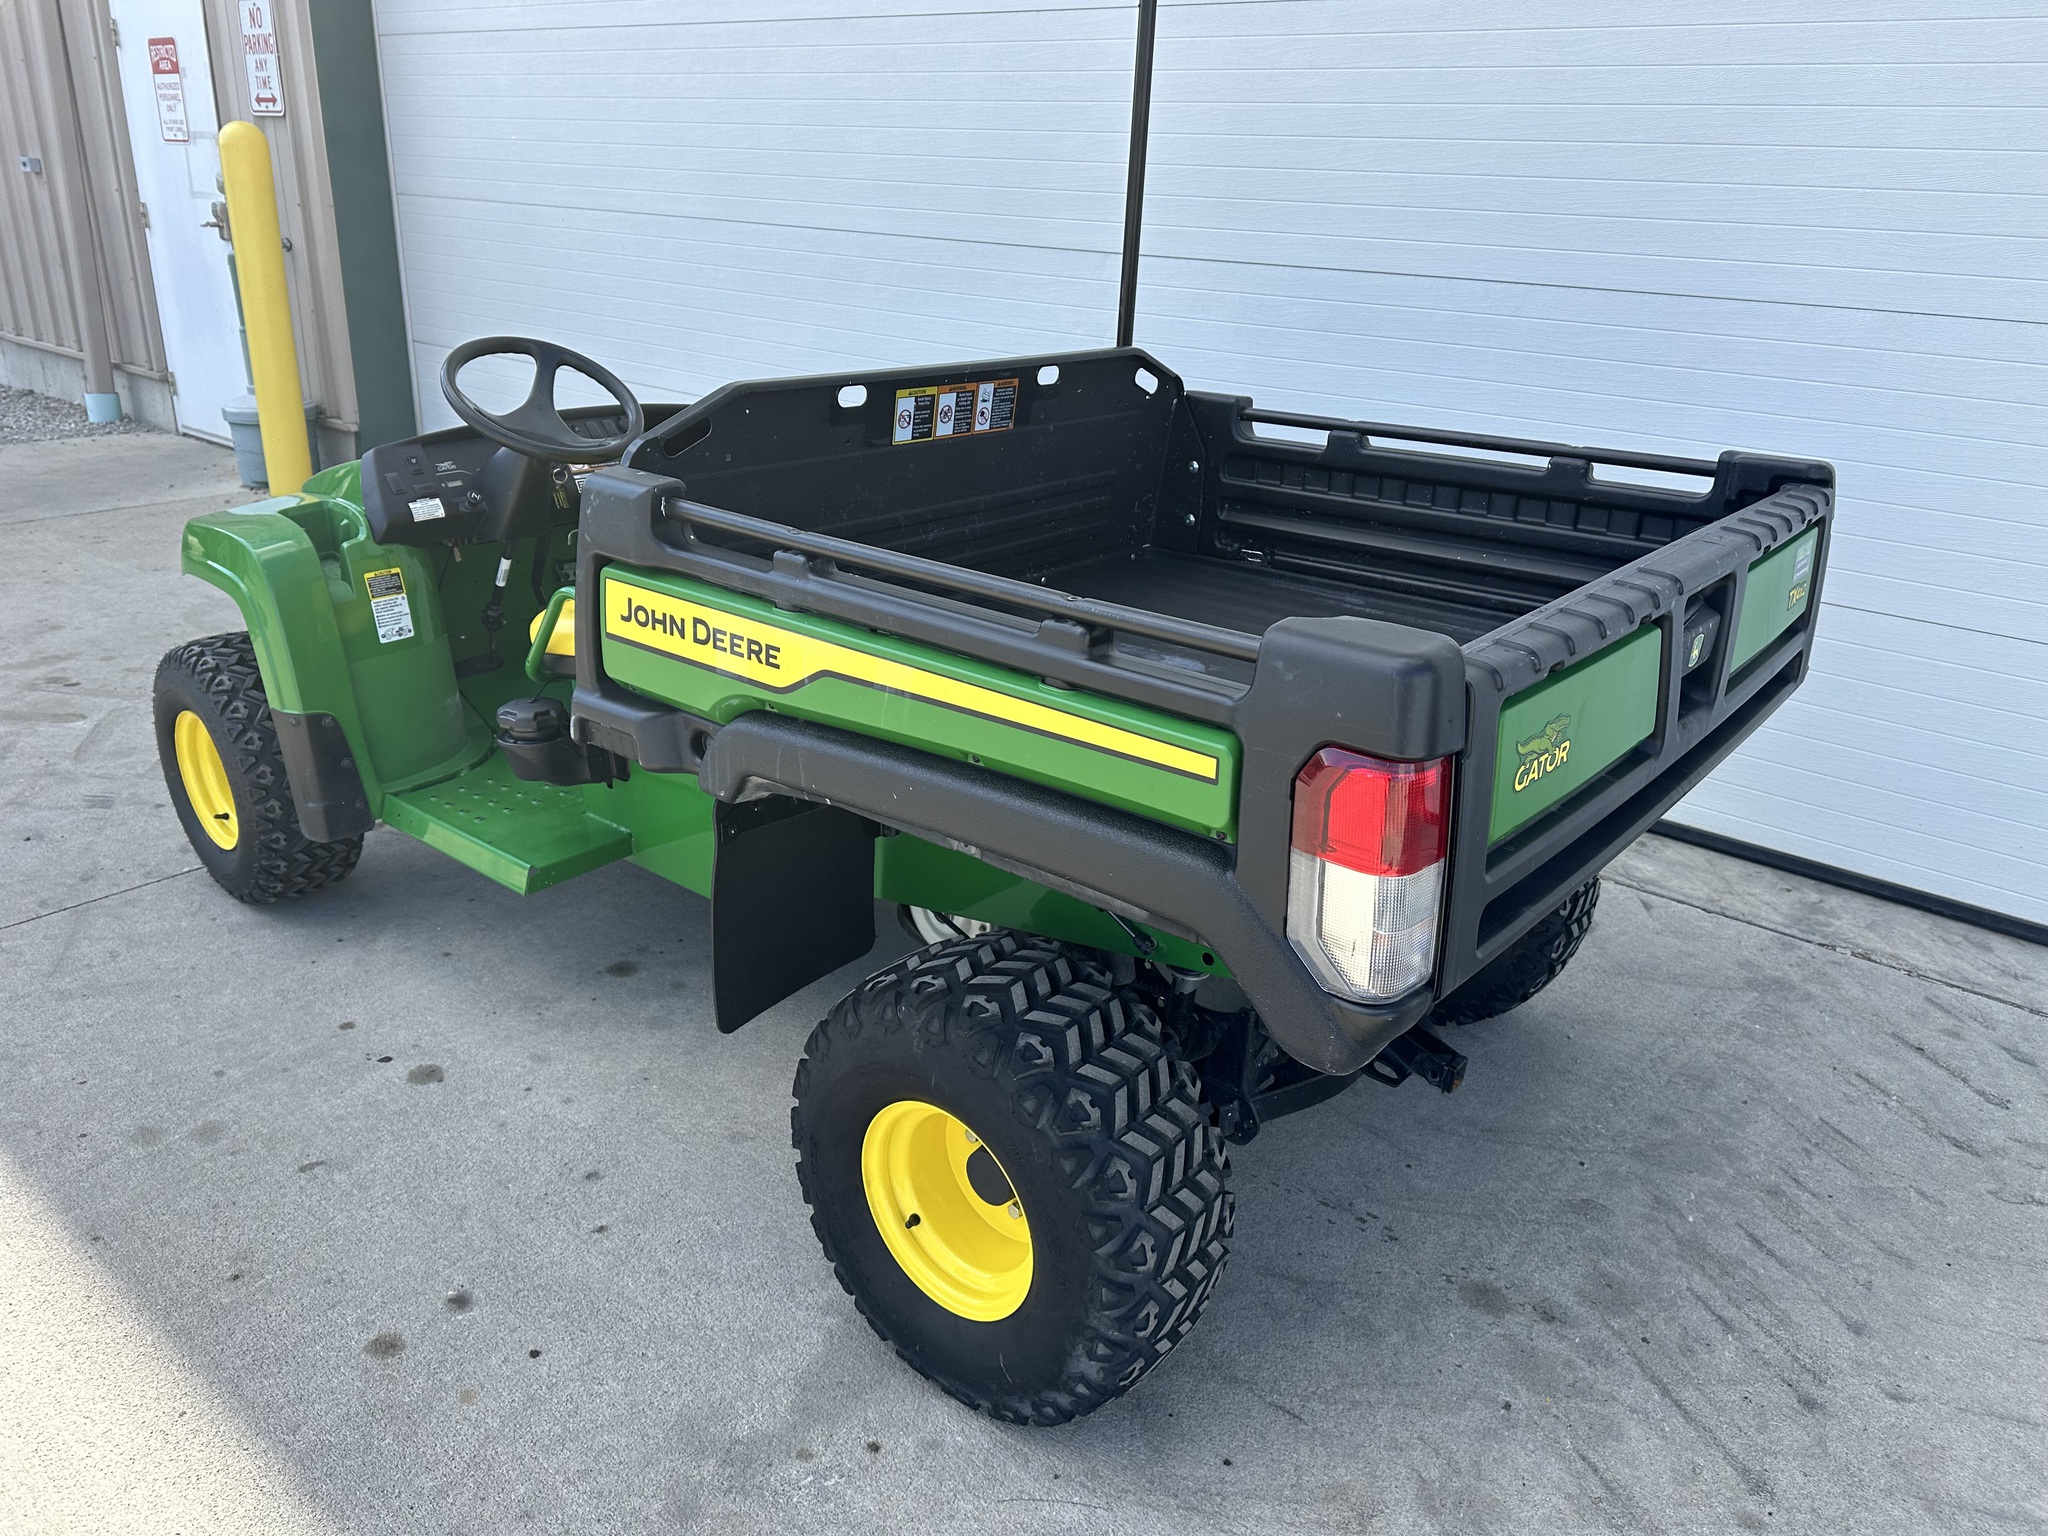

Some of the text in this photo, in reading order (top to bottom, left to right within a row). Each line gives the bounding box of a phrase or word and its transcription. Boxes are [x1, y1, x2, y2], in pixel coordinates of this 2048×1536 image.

[248, 7, 263, 29] NO
[243, 32, 274, 55] PARKING
[149, 44, 177, 63] RESTRICTED
[158, 60, 173, 71] AREA
[254, 58, 268, 73] ANY
[157, 82, 180, 91] AUTHORIZED
[254, 75, 273, 90] TIME
[158, 93, 181, 102] PERSONNEL
[166, 104, 177, 113] ONLY
[620, 597, 781, 670] JOHN DEERE
[1514, 740, 1571, 792] GATOR
